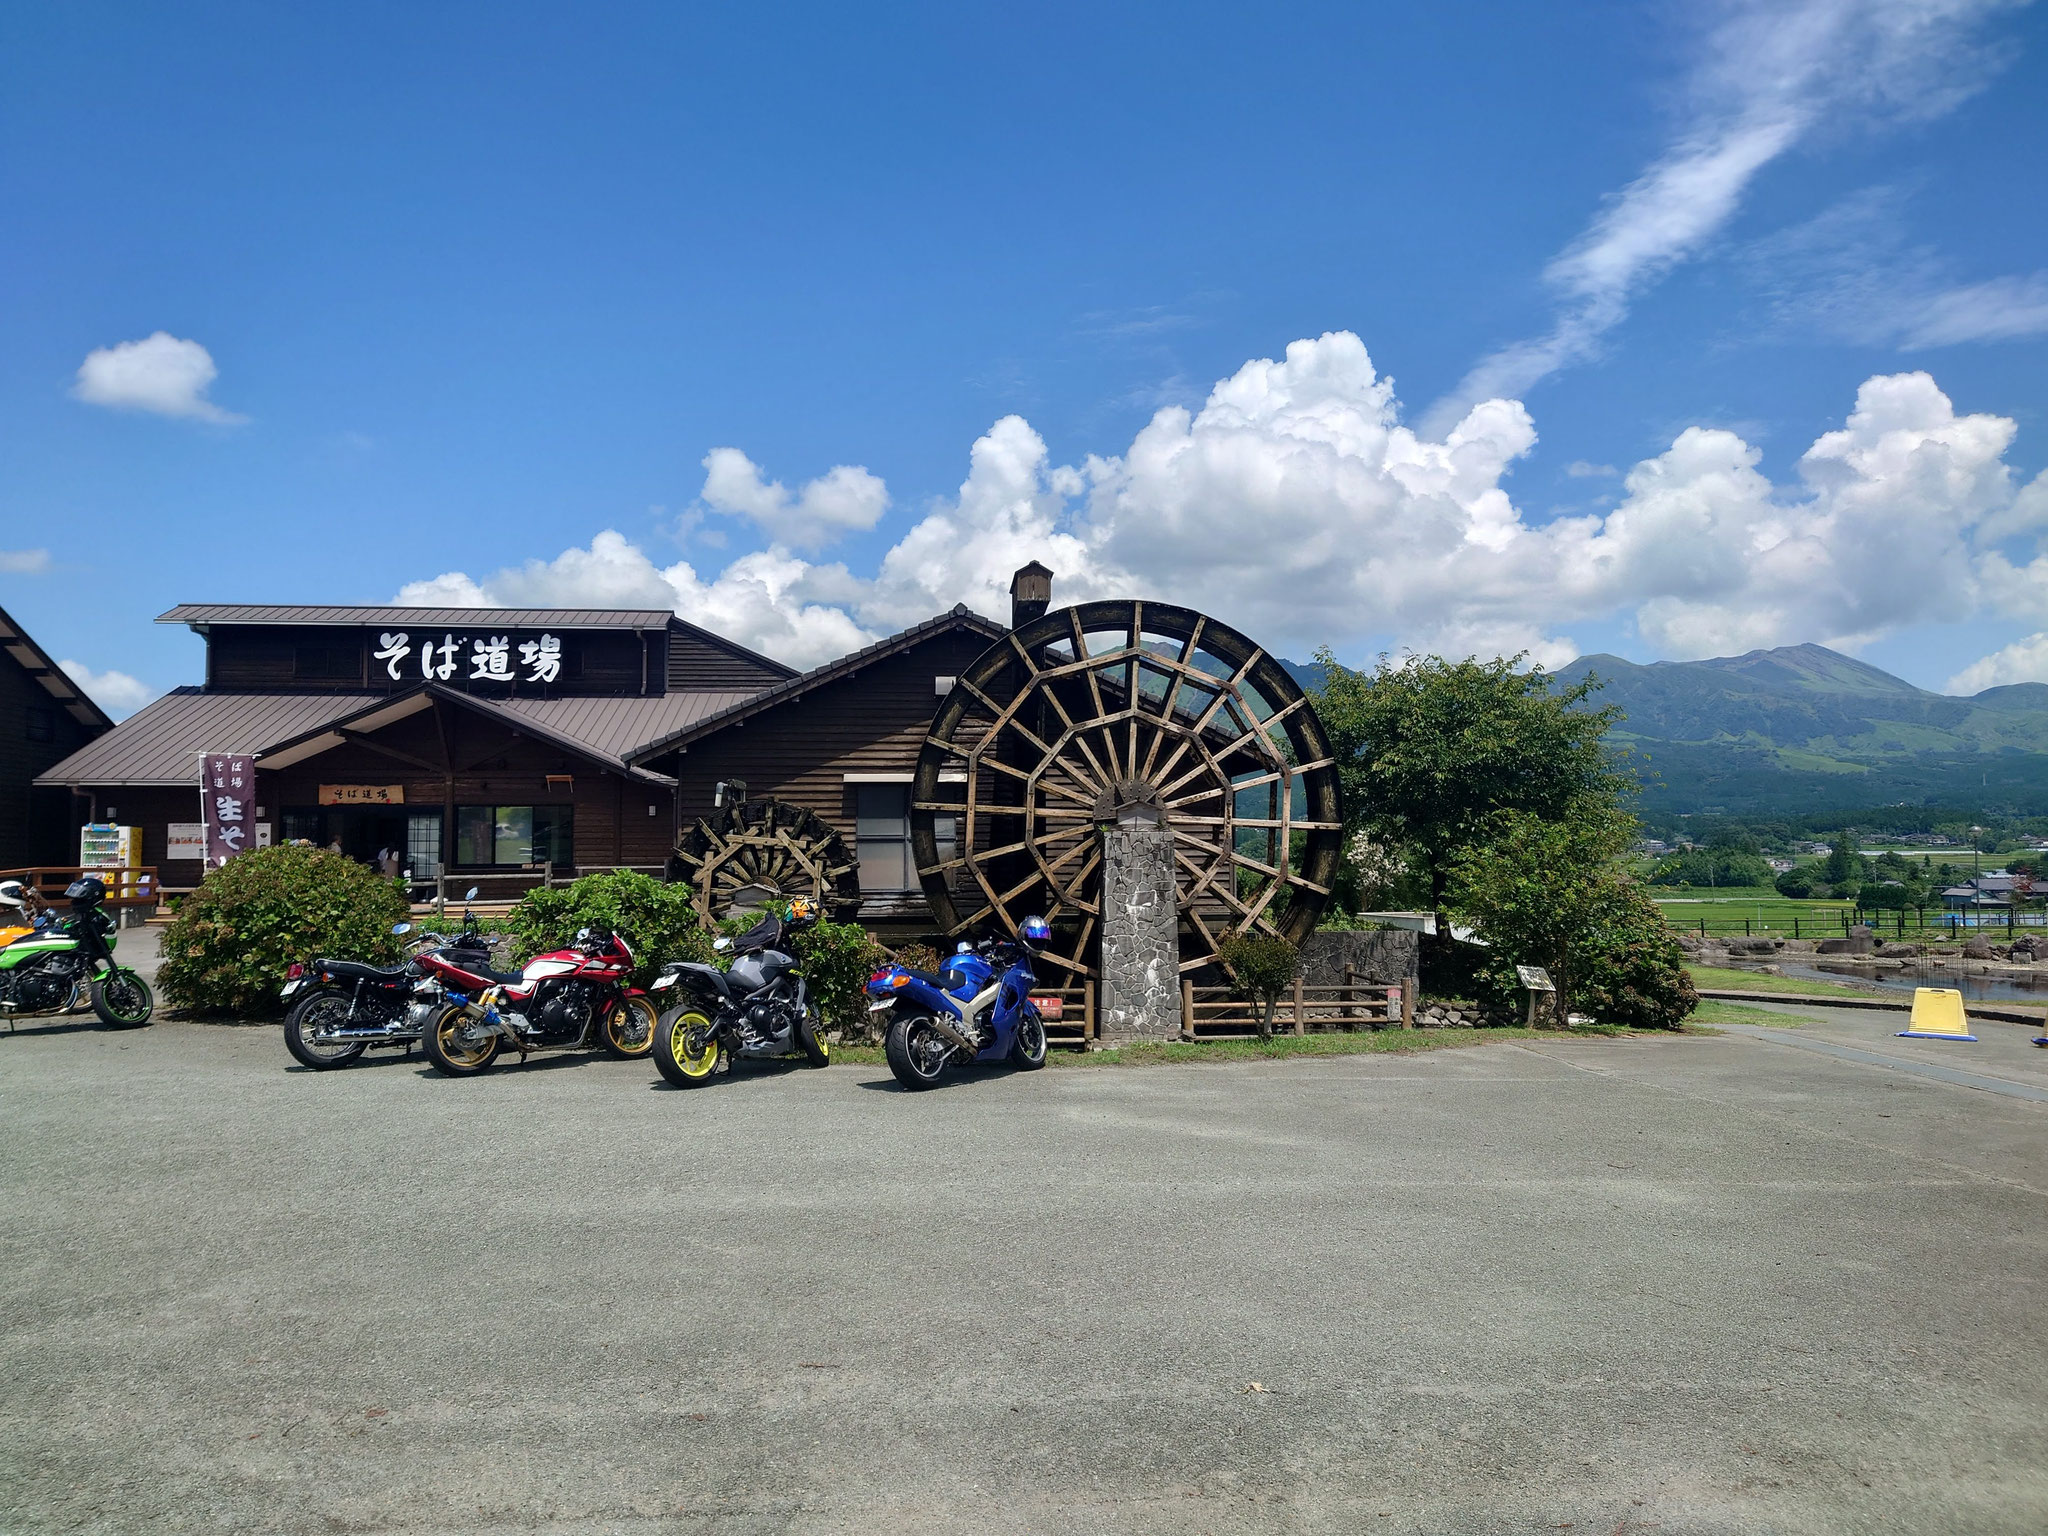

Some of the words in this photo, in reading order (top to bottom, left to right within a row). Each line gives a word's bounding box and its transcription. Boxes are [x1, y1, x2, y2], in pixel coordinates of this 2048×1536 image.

[373, 632, 562, 682] そば道場
[215, 761, 243, 772] そば
[213, 777, 243, 788] 道場
[334, 788, 388, 801] そば道場
[216, 795, 245, 866] 生そ
